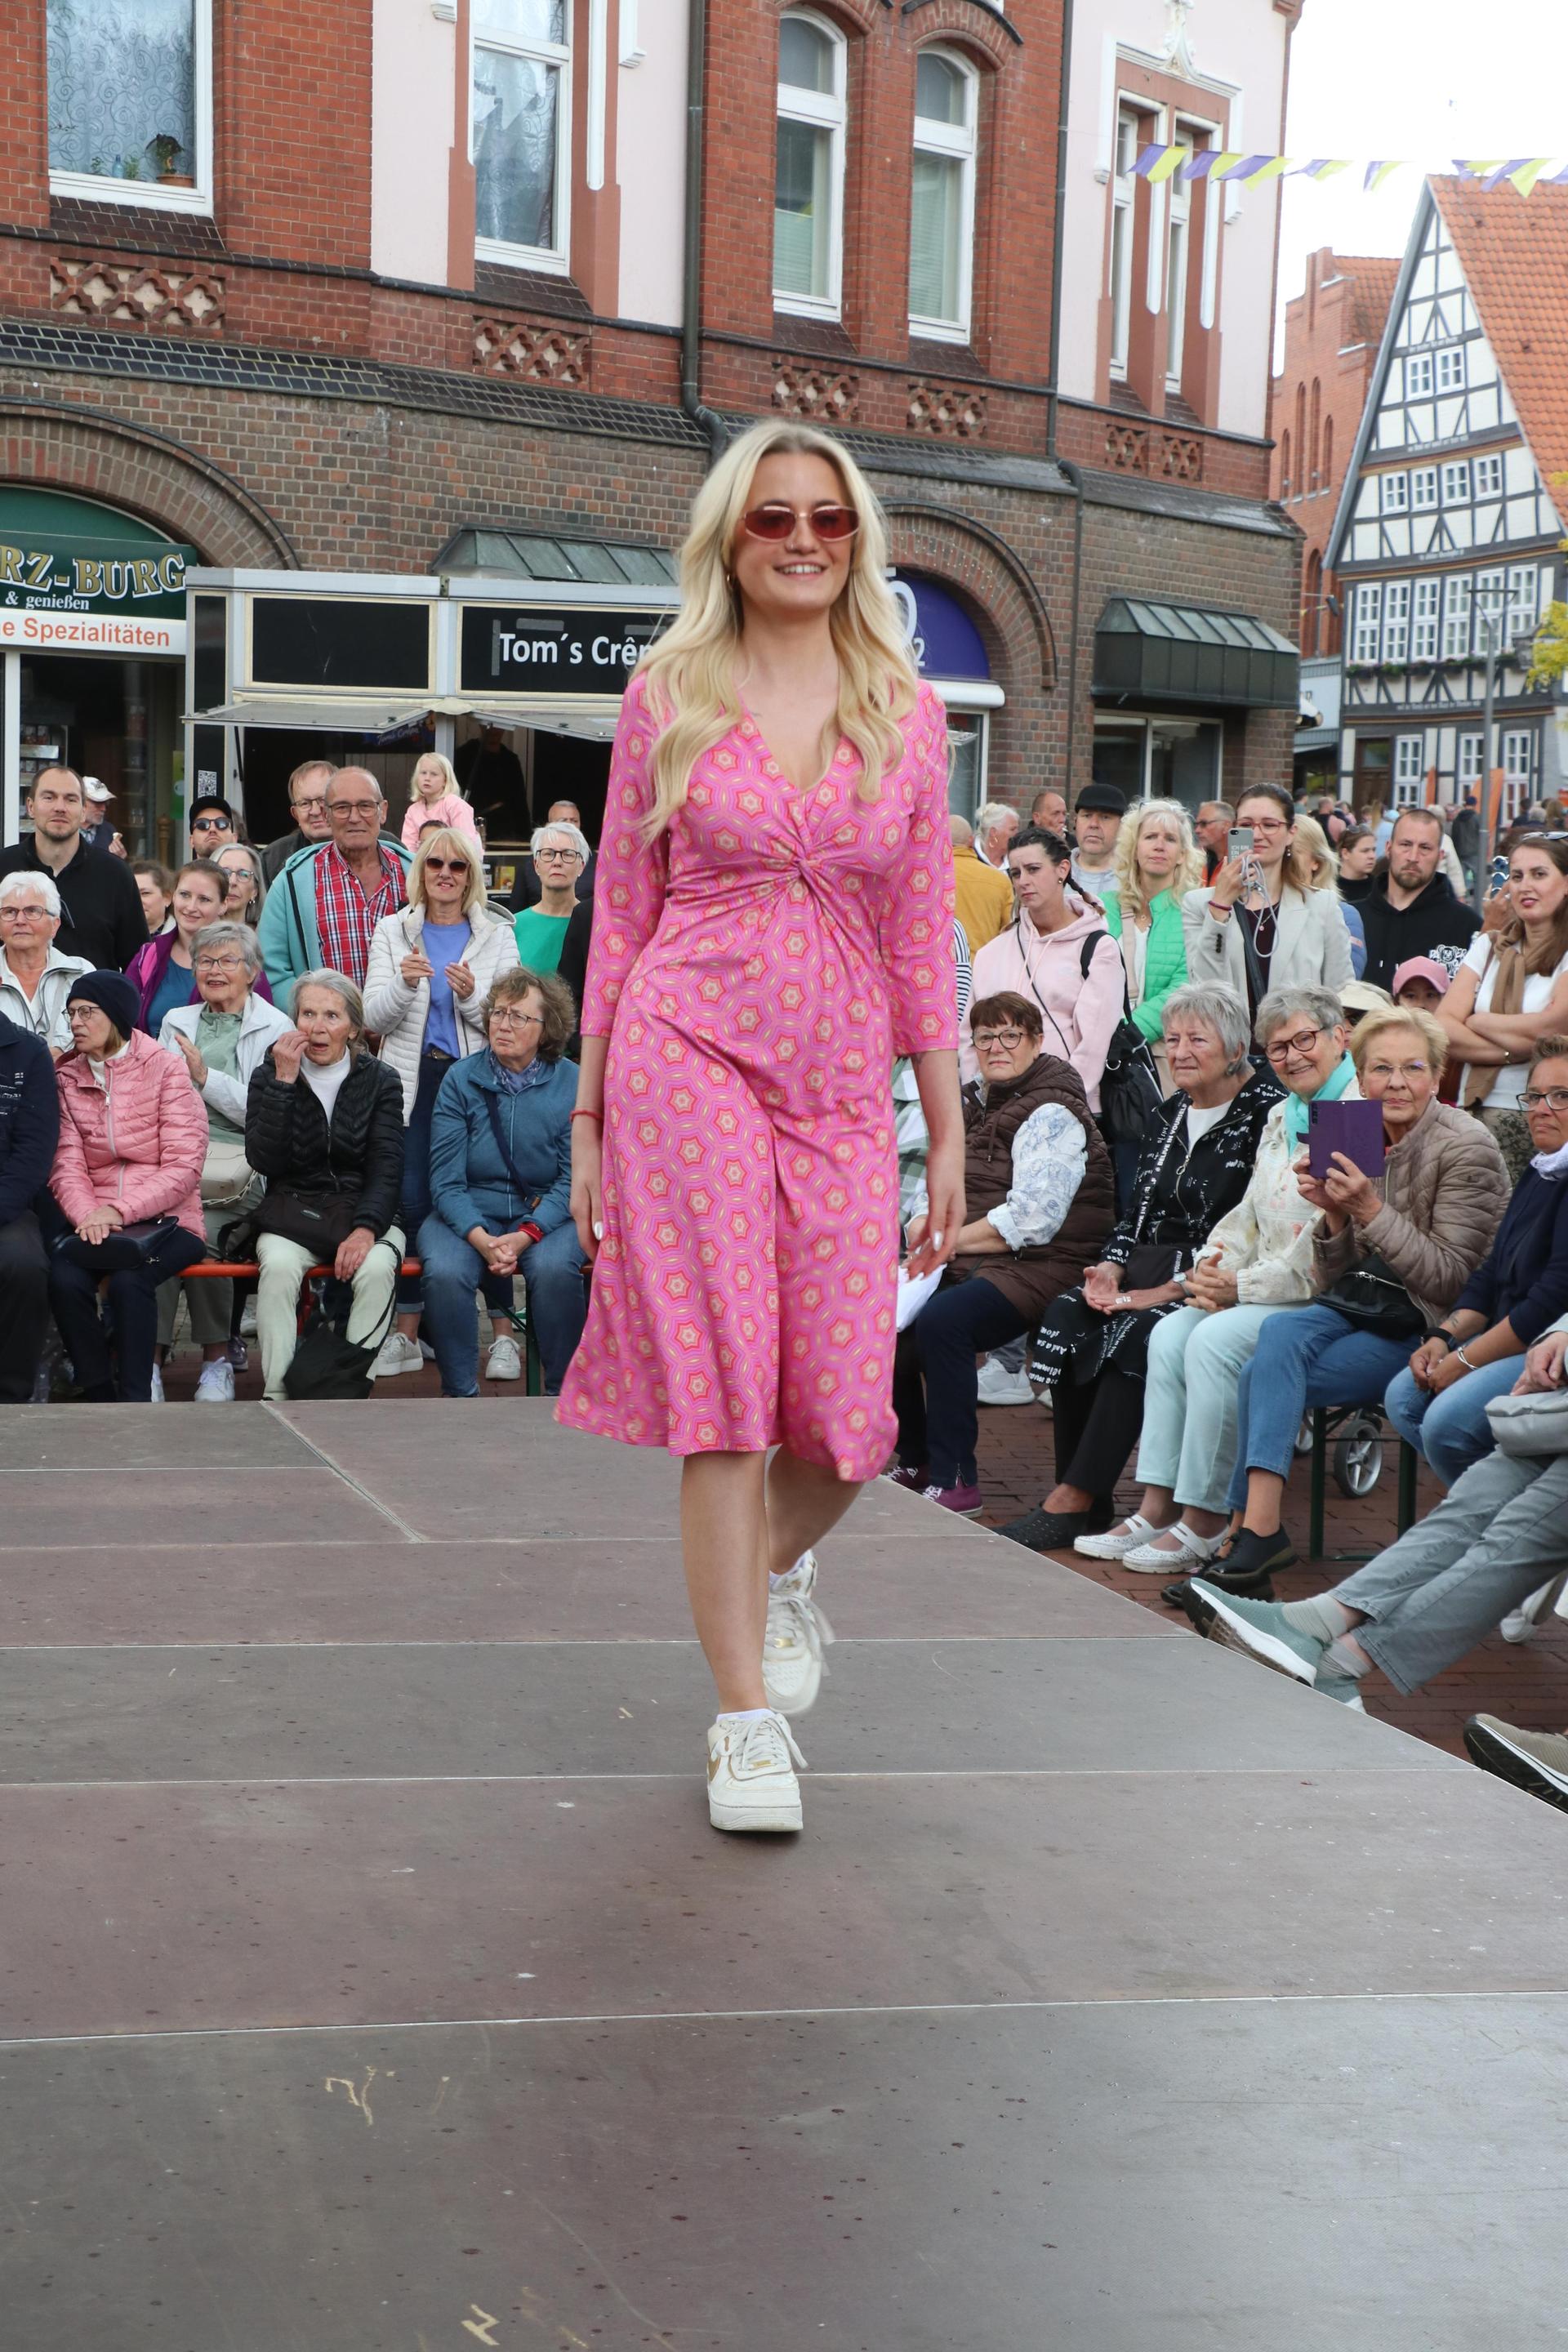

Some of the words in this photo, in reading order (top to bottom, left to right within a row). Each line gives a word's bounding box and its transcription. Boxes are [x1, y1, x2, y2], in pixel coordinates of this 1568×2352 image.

[5, 590, 19, 606] &
[25, 593, 90, 610] genießen
[24, 617, 170, 647] Spezialitäten
[1169, 1102, 1187, 1135] YOURSELF
[1166, 1134, 1174, 1143] IN
[1156, 1143, 1171, 1166] BELIVE
